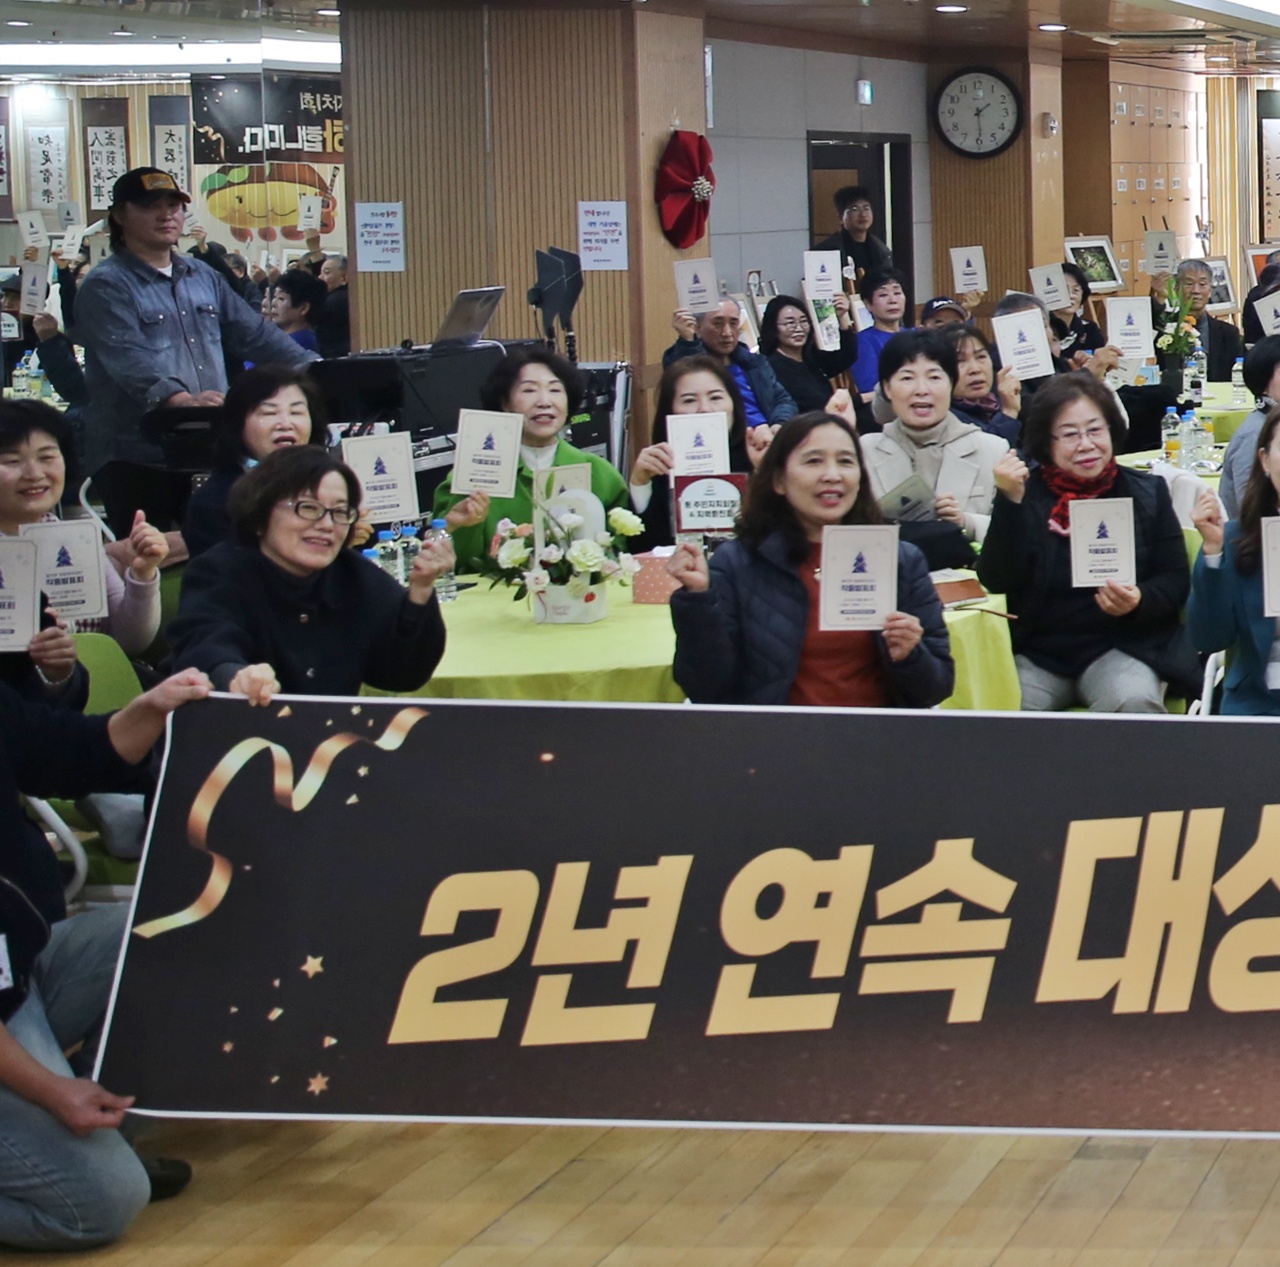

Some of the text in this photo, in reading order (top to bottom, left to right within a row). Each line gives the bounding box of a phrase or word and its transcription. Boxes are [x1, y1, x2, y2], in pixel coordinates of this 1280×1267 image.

[959, 84, 967, 94] 11
[973, 81, 982, 90] 12
[991, 84, 995, 94] 1
[949, 95, 960, 104] 10
[1000, 94, 1006, 104] 2
[947, 108, 955, 118] 9
[1002, 107, 1009, 118] 3
[952, 122, 959, 132] 8
[998, 122, 1005, 131] 4
[961, 132, 968, 142] 7
[975, 137, 983, 145] 6
[990, 132, 997, 142] 5
[386, 854, 694, 1046] 2년
[705, 837, 1019, 1036] 연속
